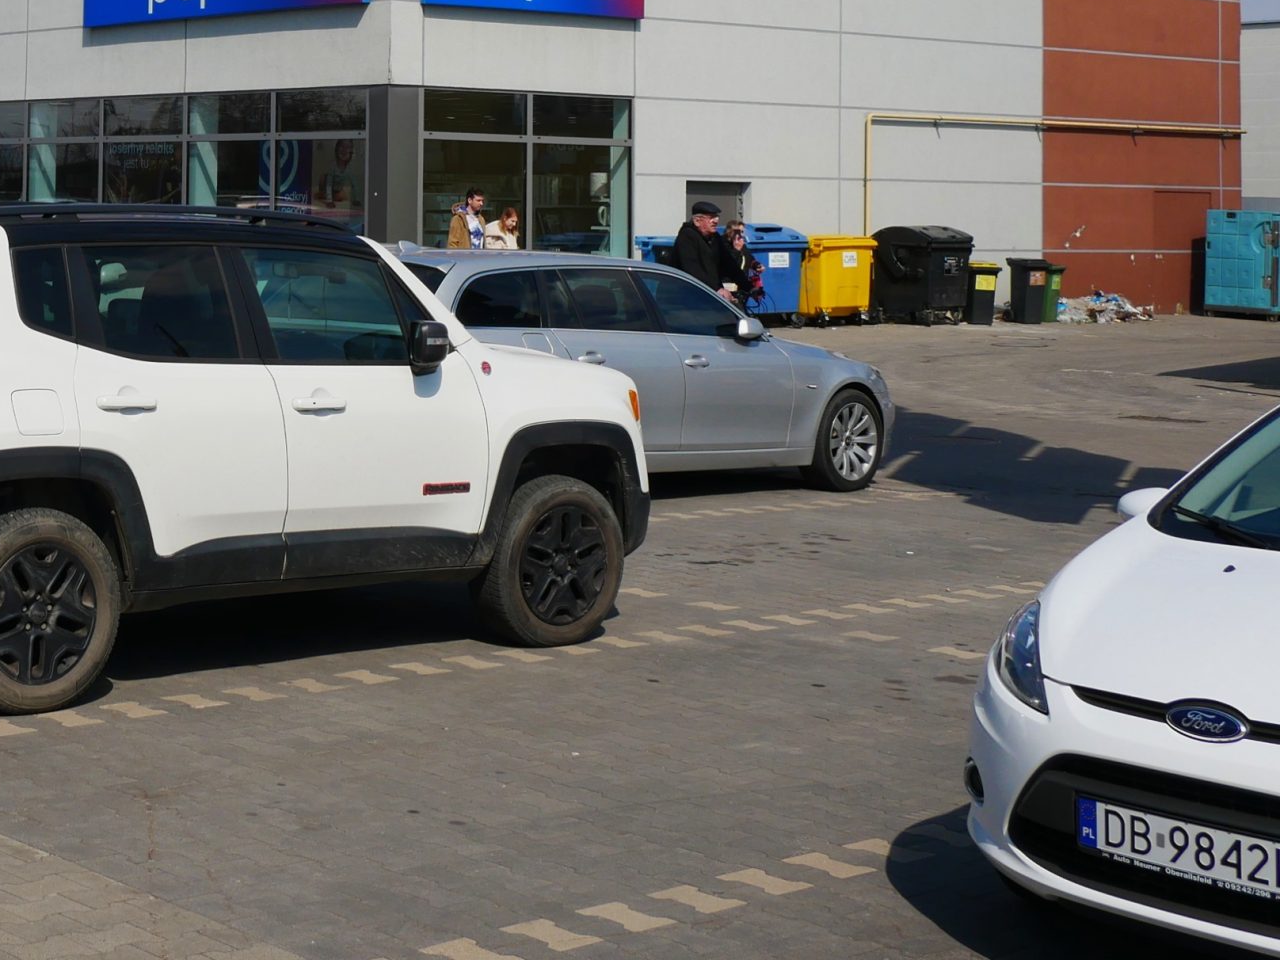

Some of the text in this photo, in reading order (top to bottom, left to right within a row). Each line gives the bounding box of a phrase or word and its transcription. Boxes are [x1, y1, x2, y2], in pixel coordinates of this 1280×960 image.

[1180, 710, 1226, 734] Ford
[1082, 826, 1096, 839] PL
[1104, 808, 1280, 888] DB 9842
[1113, 855, 1131, 865] Auto
